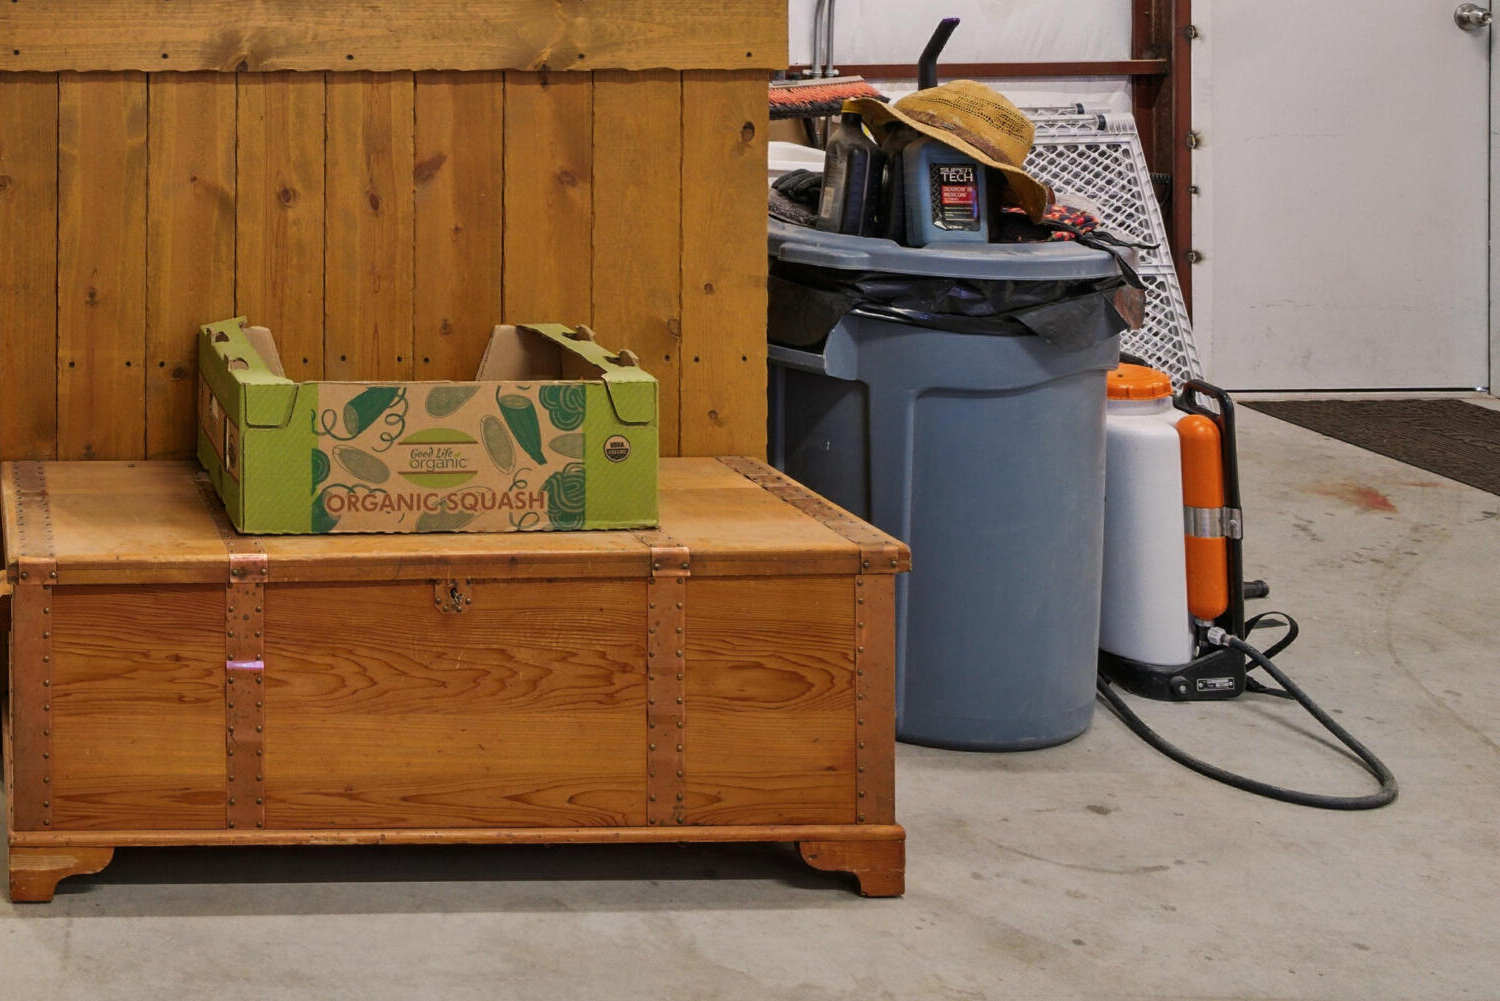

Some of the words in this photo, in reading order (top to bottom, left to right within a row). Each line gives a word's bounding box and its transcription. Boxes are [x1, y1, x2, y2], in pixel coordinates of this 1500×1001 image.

[941, 173, 973, 182] TECH
[410, 446, 434, 459] Good
[436, 447, 453, 459] Life
[409, 458, 468, 472] organic
[326, 492, 440, 513] ORGANIC
[445, 490, 545, 512] SQUASH
